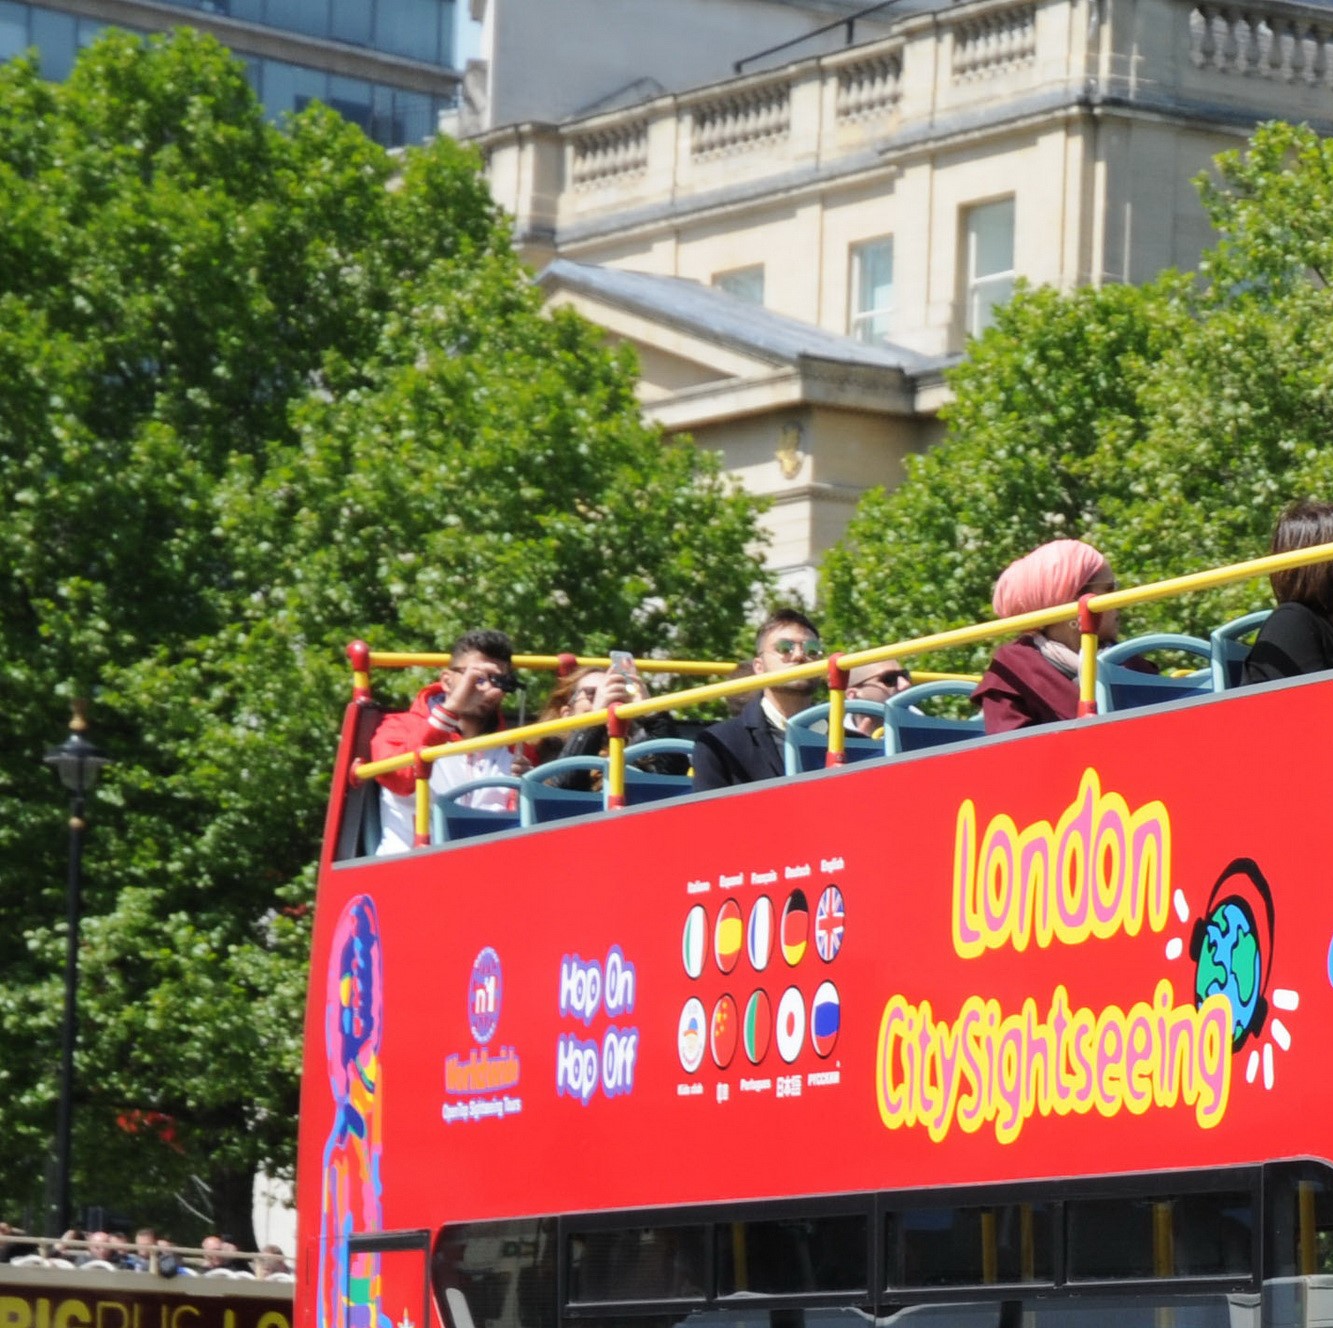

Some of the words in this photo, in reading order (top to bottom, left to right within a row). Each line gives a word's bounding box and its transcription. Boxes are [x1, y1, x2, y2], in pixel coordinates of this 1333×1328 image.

[952, 767, 1171, 959] London
[560, 956, 601, 1023] Hop
[604, 946, 636, 1015] On
[557, 1036, 598, 1104] Hop
[602, 1027, 639, 1096] Off
